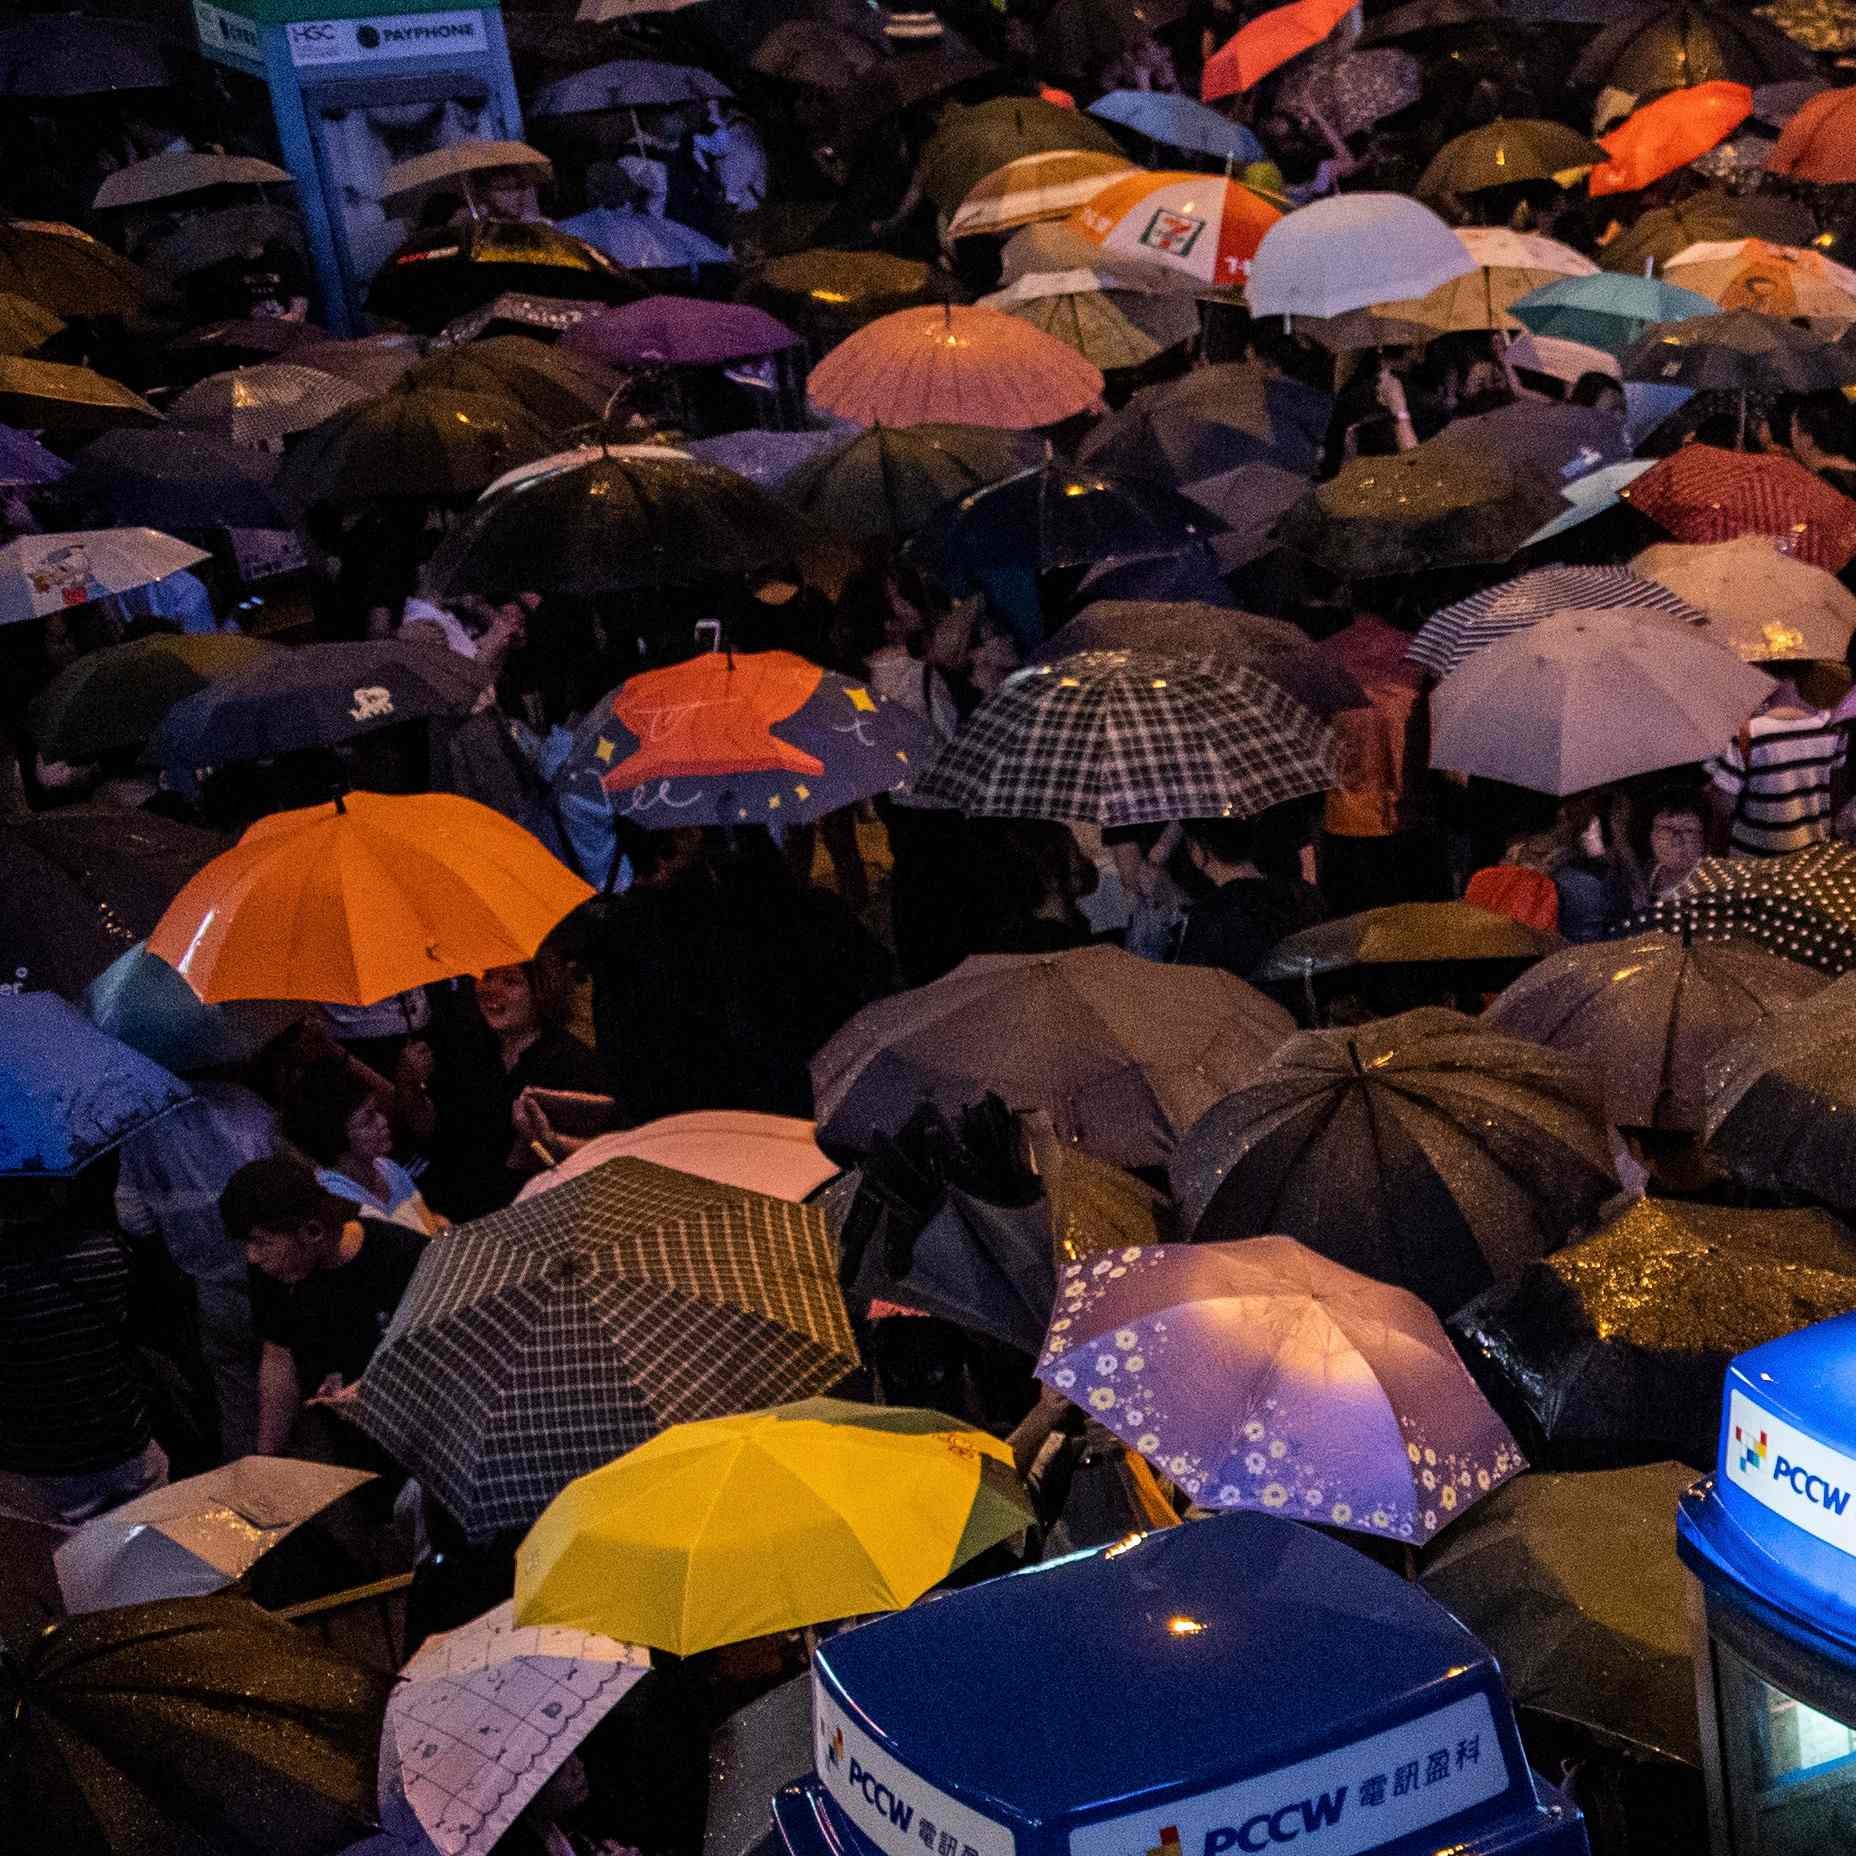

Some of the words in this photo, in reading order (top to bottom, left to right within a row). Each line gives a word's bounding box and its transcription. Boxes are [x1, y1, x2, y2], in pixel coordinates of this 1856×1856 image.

[292, 23, 335, 42] HGC
[383, 23, 474, 42] PAYPHONE
[1773, 1454, 1851, 1517] PCCW
[848, 1757, 915, 1834] PCCW
[1358, 1732, 1483, 1810] 電訊盈科
